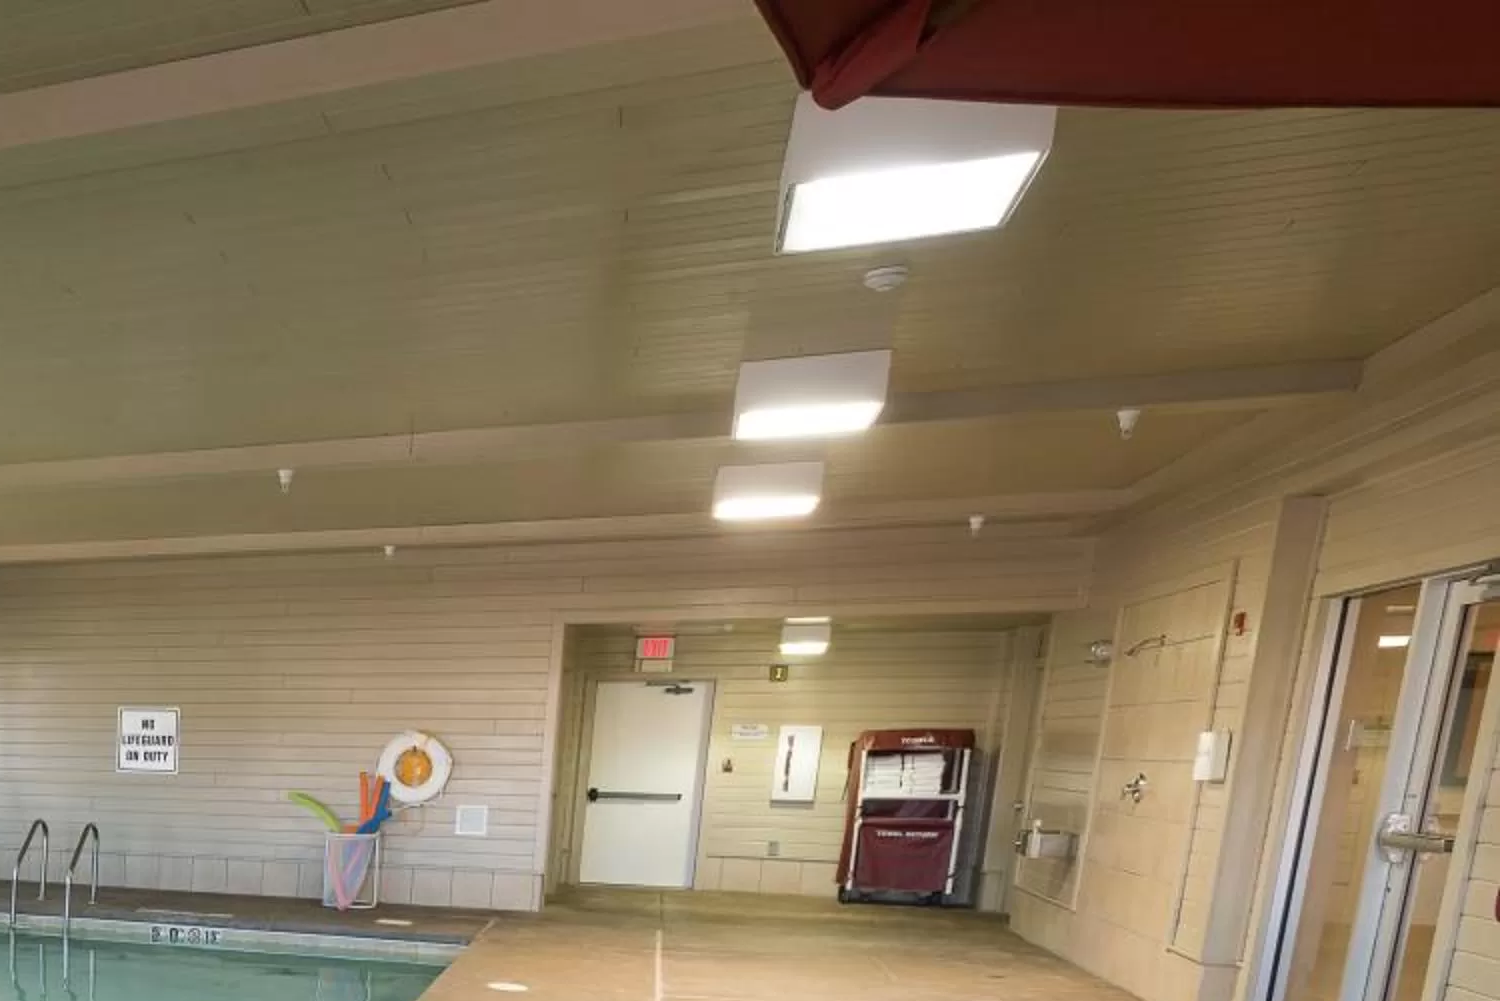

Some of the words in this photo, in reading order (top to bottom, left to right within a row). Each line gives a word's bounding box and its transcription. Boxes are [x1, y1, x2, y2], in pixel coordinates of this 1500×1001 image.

[122, 735, 174, 746] LIFEGUARD
[125, 751, 139, 761] ON
[143, 751, 168, 762] DUTY
